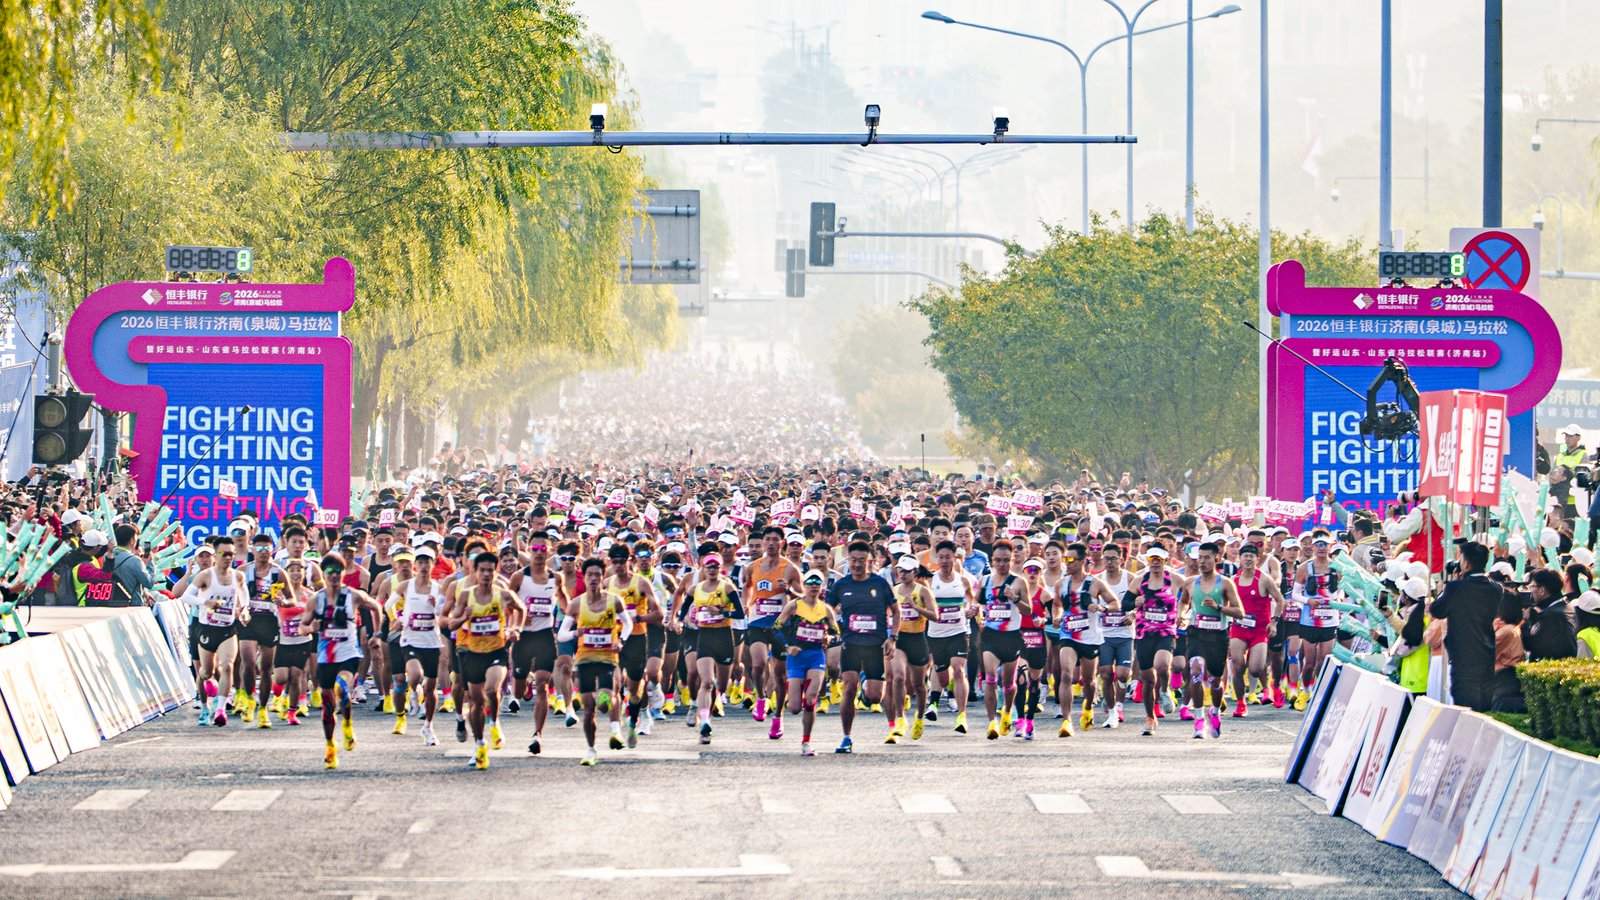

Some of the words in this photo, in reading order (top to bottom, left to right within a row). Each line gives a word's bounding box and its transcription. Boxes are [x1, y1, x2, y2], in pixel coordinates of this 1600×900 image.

[166, 289, 208, 300] 恒丰银行
[234, 290, 259, 298] 2026
[1377, 294, 1419, 305] 恒丰银行
[1445, 295, 1470, 303] 2026
[120, 315, 333, 332] 2026恒丰银行济南(泉城)马拉松
[1297, 319, 1508, 336] 2026恒丰银行济南(泉城)马拉松
[163, 406, 314, 432] FIGHTING
[161, 435, 313, 461] FIGHTING
[1312, 439, 1420, 464] FIGHTI
[160, 464, 313, 490] FIGHTING
[1312, 469, 1420, 494] FIGHTI
